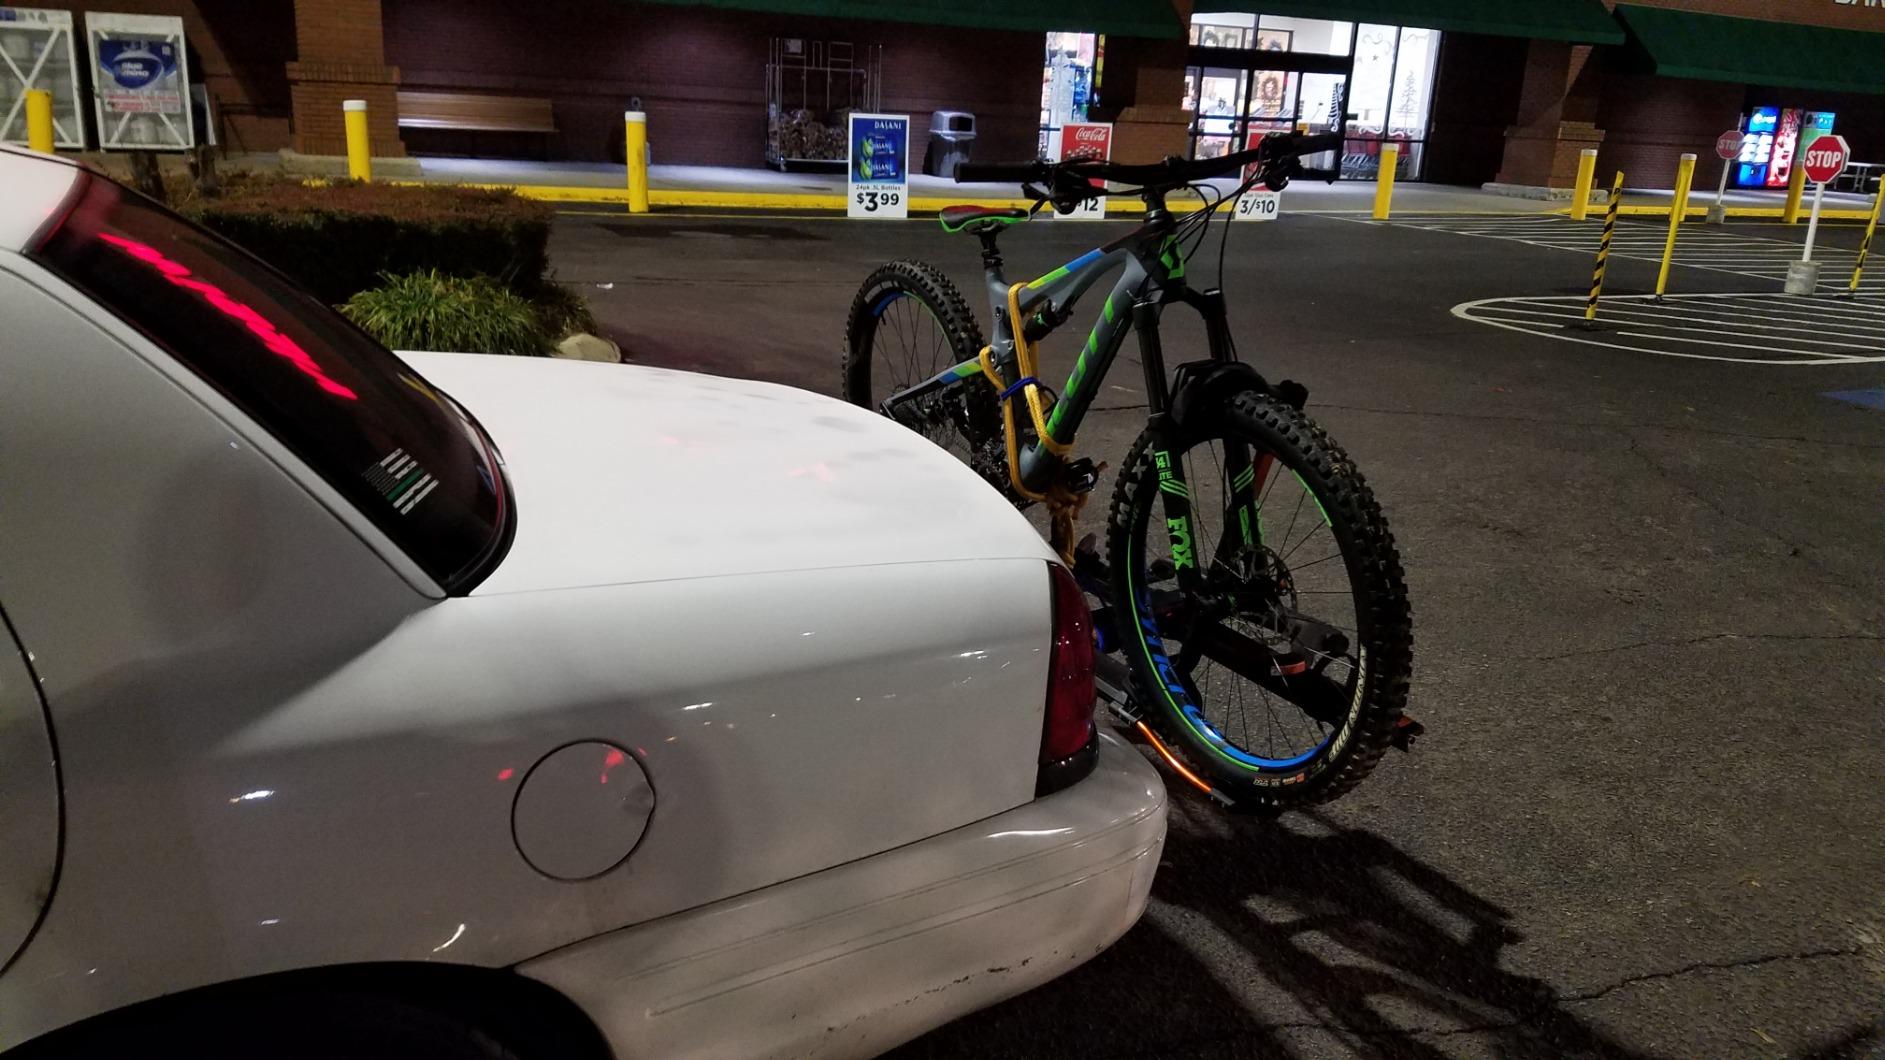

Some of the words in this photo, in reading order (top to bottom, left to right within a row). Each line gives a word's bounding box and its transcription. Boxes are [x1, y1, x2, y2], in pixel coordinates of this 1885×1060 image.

[874, 121, 902, 129] DASANI
[1806, 150, 1842, 168] STOP
[1077, 196, 1099, 211] 12
[1240, 198, 1275, 215] 3/$10
[1167, 515, 1194, 571] FOX
